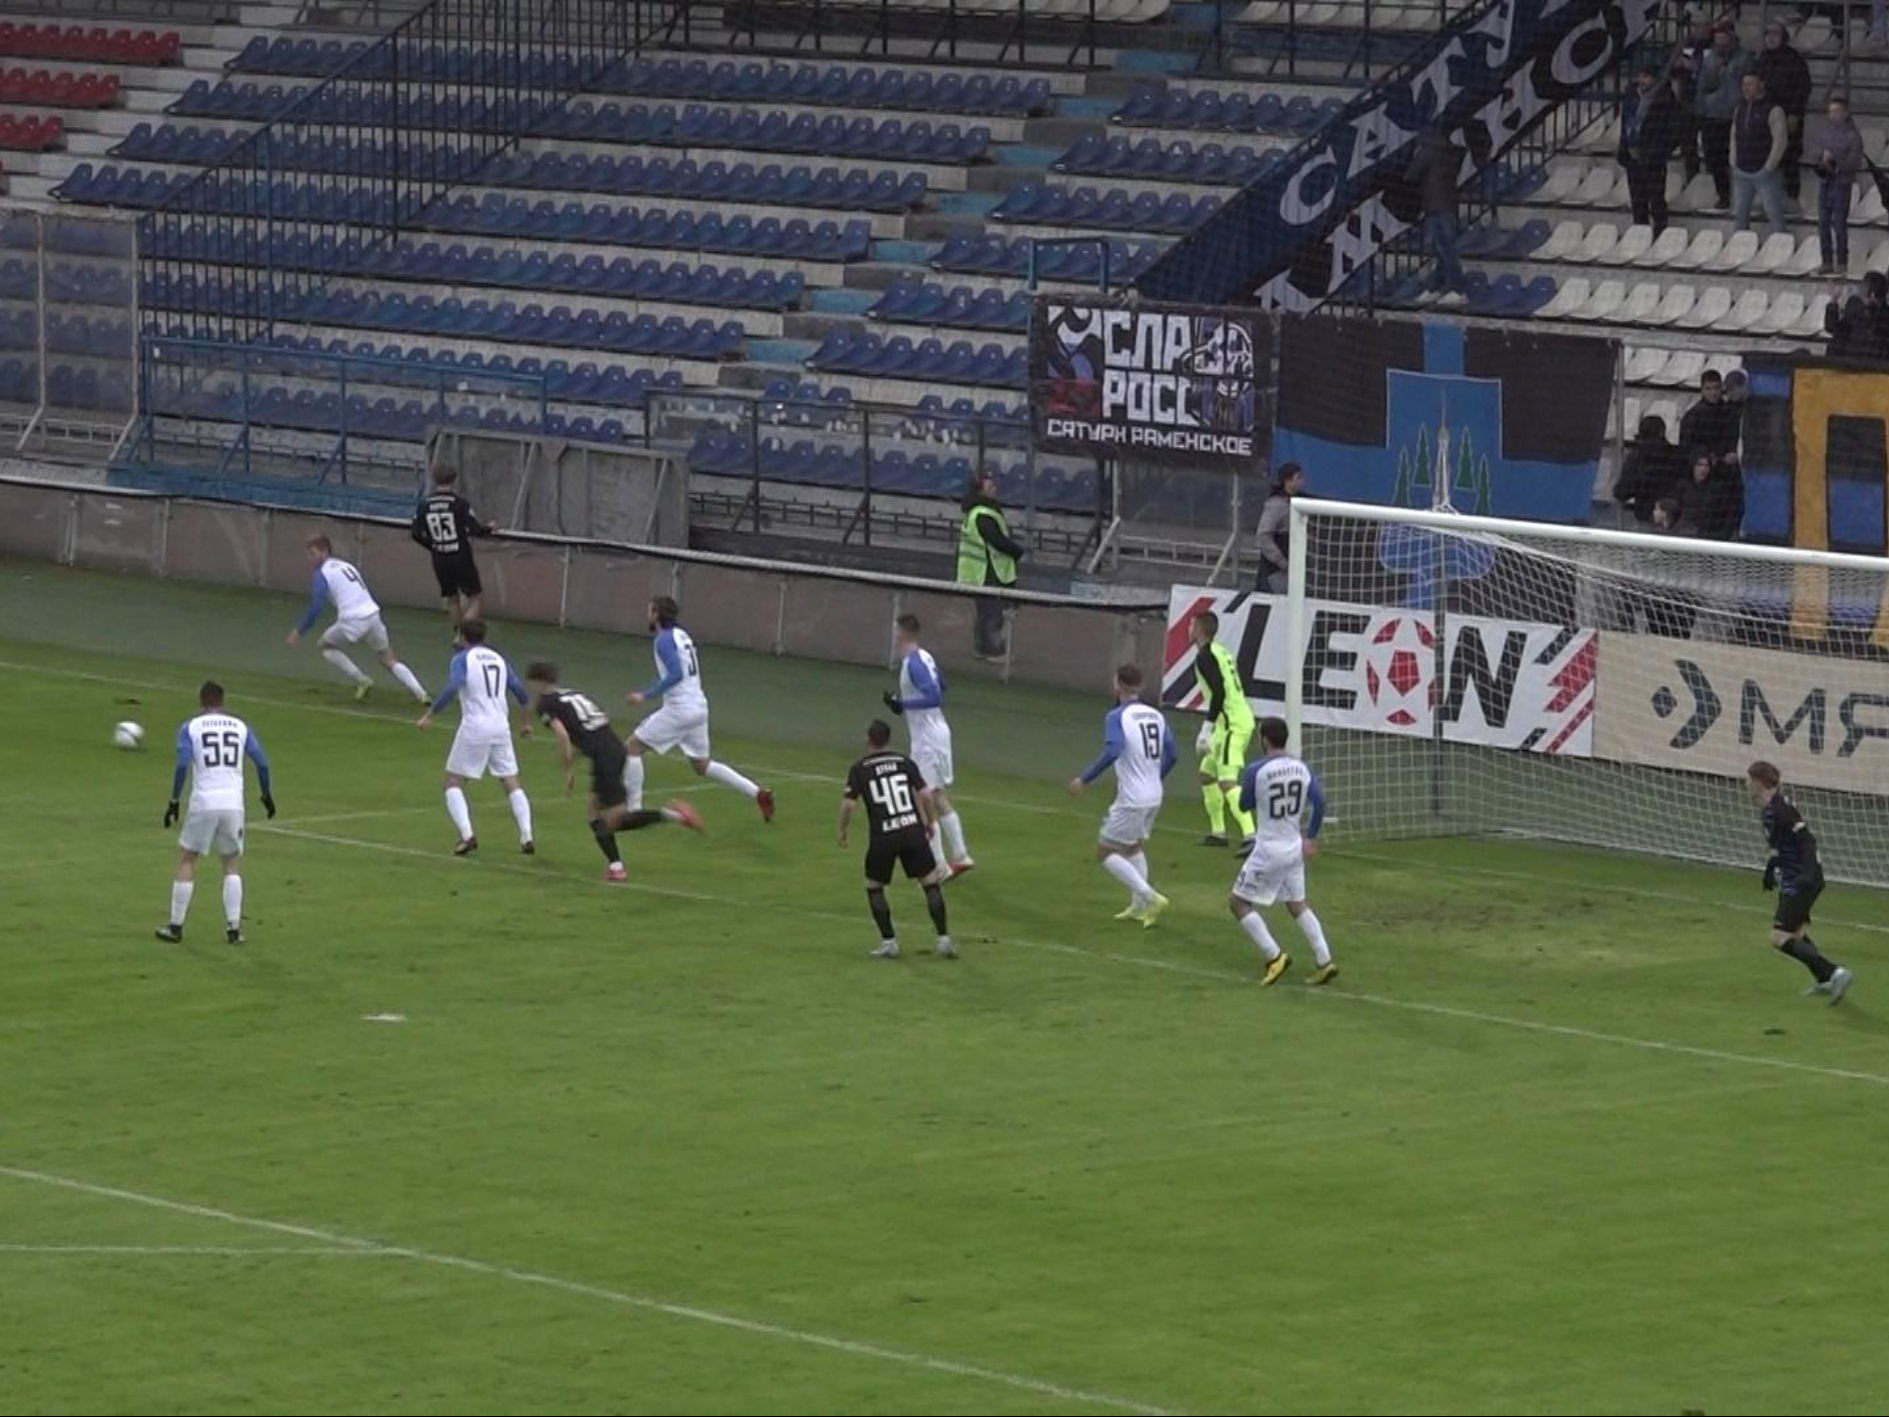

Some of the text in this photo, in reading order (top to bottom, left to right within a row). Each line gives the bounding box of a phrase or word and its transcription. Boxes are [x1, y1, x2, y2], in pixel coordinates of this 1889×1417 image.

[1279, 0, 1570, 226] САТУ
[1047, 418, 1253, 456] САТУРН РАМЕНСКОЕ
[426, 513, 458, 541] 83
[482, 664, 500, 699] 17
[1236, 602, 1529, 728] LEON
[202, 731, 239, 768] 55
[1139, 722, 1160, 760] 19
[869, 773, 914, 815] 46
[1268, 780, 1302, 820] 29
